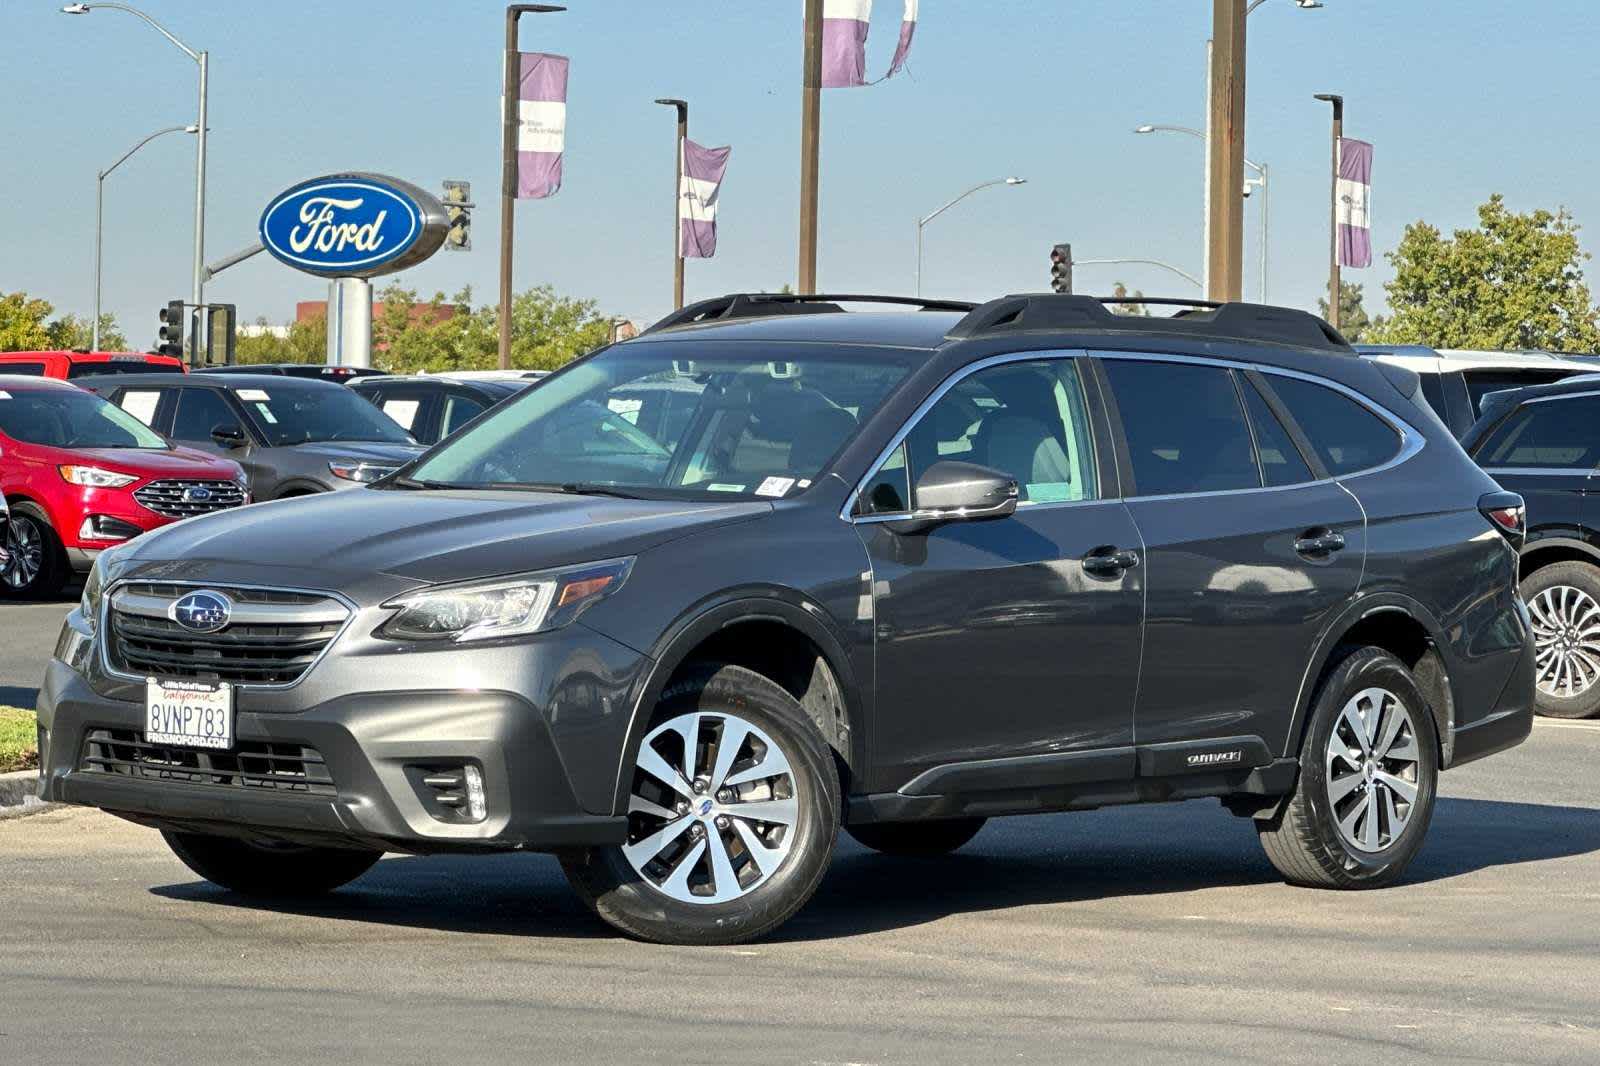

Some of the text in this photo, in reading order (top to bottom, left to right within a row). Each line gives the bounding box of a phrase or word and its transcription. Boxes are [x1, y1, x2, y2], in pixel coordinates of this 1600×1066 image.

[289, 197, 387, 253] Ford
[151, 704, 225, 737] 8VNP783
[146, 732, 229, 749] FRESNOFORD.COM
